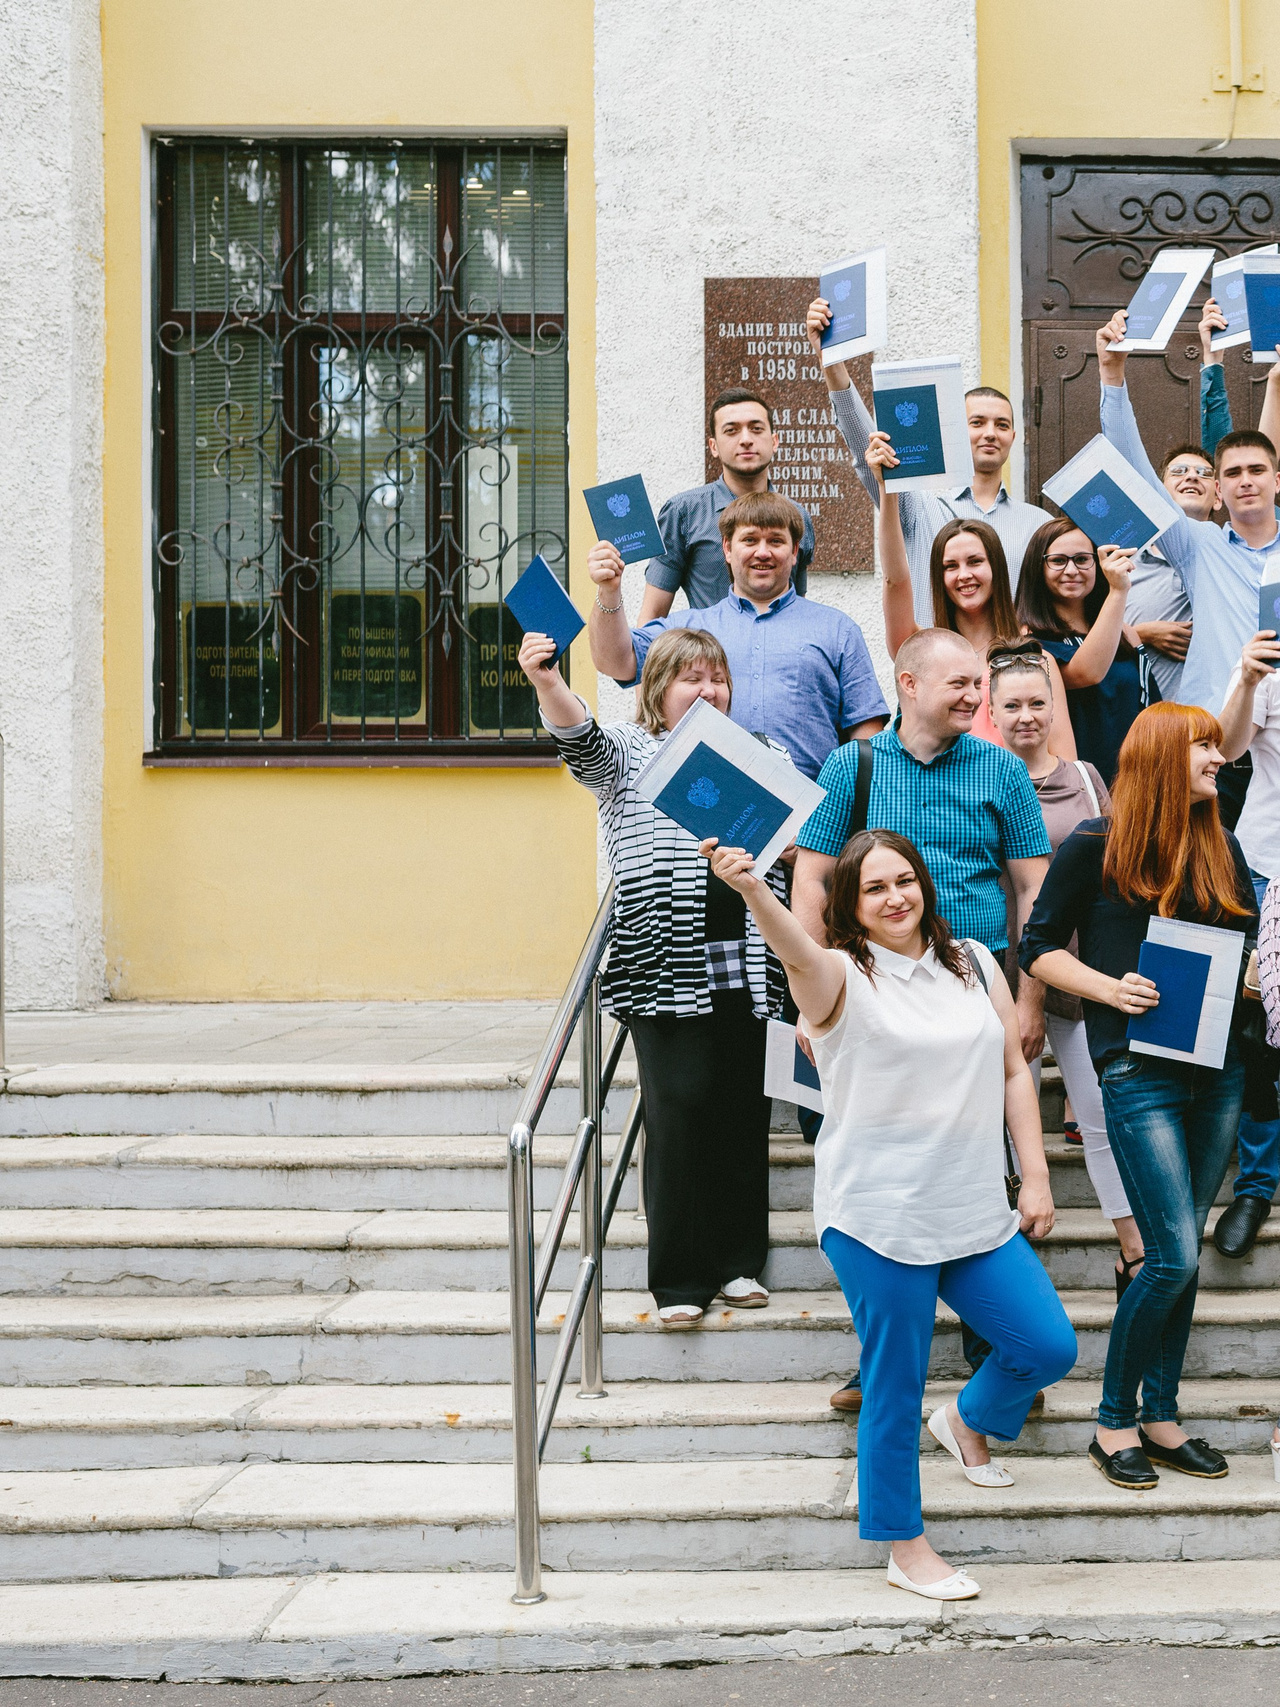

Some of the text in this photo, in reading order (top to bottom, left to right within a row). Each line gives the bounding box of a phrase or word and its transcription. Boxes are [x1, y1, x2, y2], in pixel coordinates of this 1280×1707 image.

[718, 322, 774, 338] ЗДАНИЕ
[747, 341, 818, 355] ПОСТРОЕ
[757, 358, 797, 381] 1958
[771, 447, 849, 462] ТЕЛЬСТВА:
[614, 530, 646, 545] ДИПЛОМ
[726, 803, 757, 841] ДИПЛОМ
